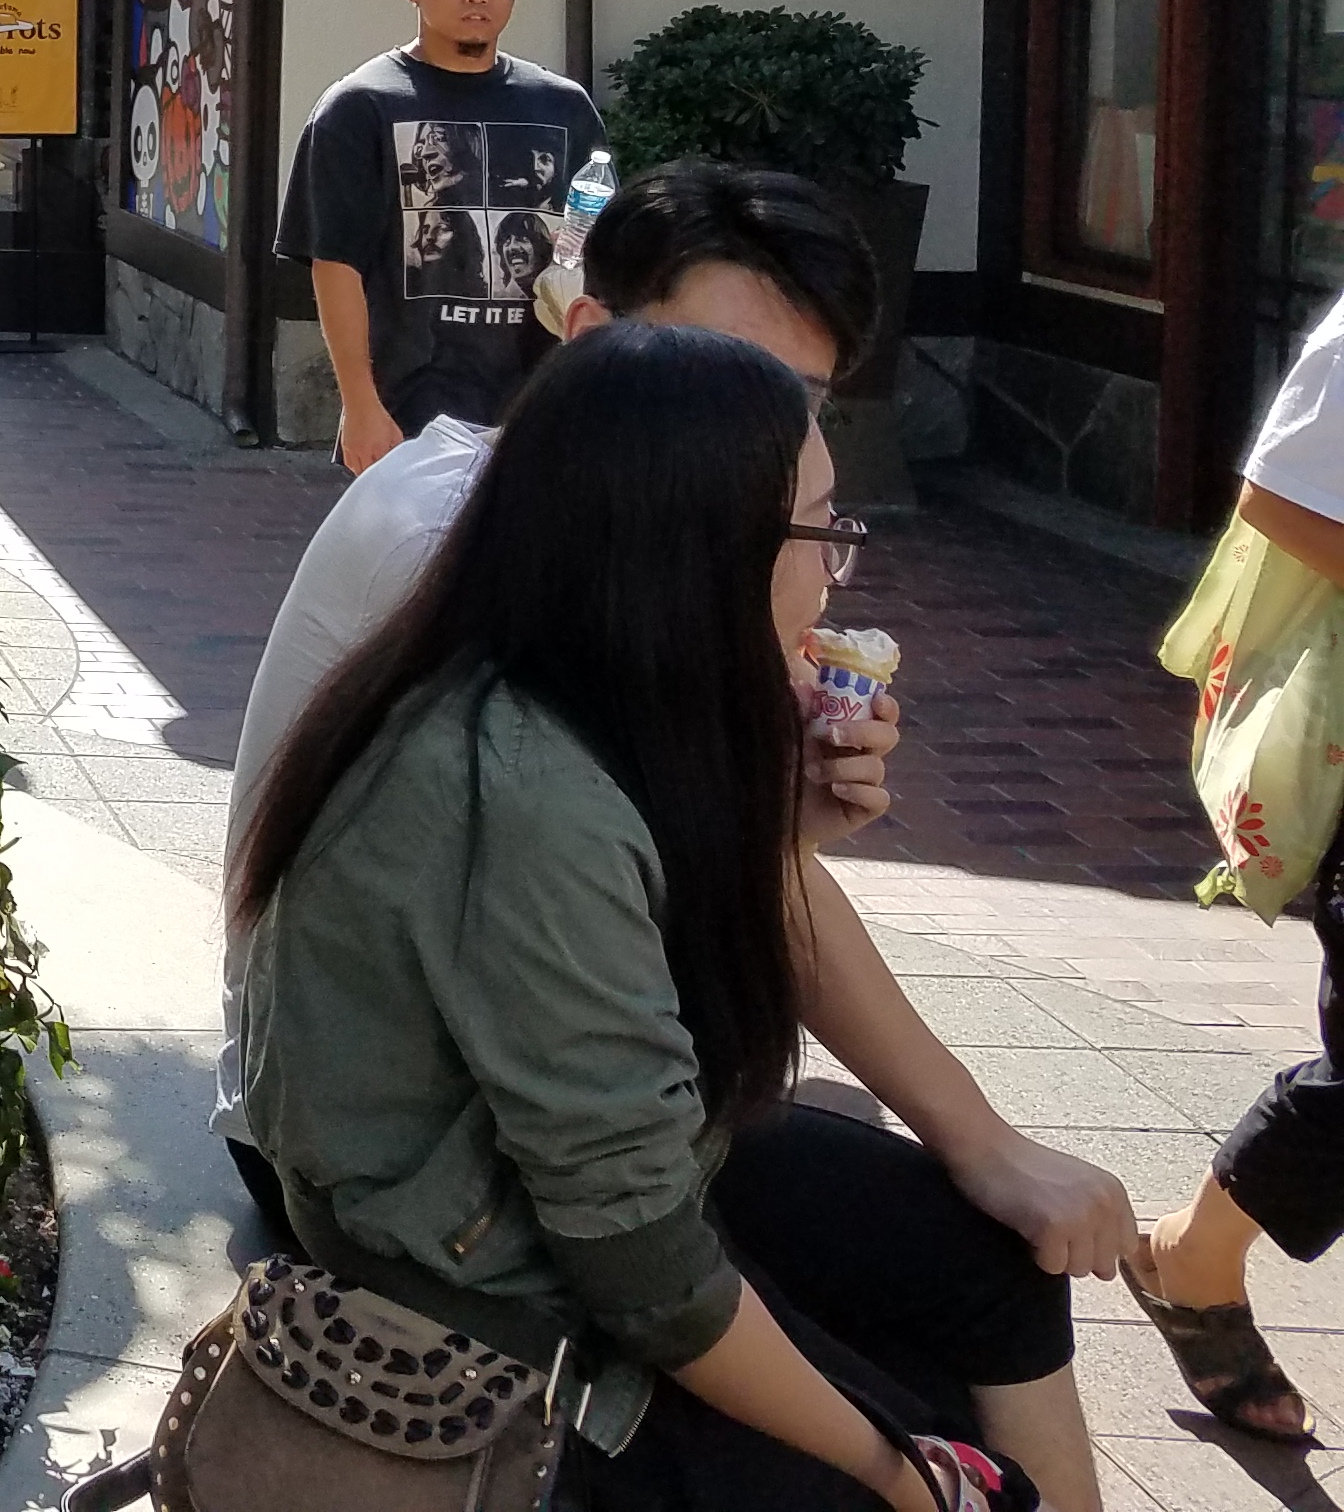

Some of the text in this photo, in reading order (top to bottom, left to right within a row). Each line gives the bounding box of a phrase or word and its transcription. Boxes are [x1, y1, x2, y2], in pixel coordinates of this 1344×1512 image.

[441, 304, 481, 324] LET
[485, 308, 503, 324] IT
[811, 690, 863, 725] Joy
